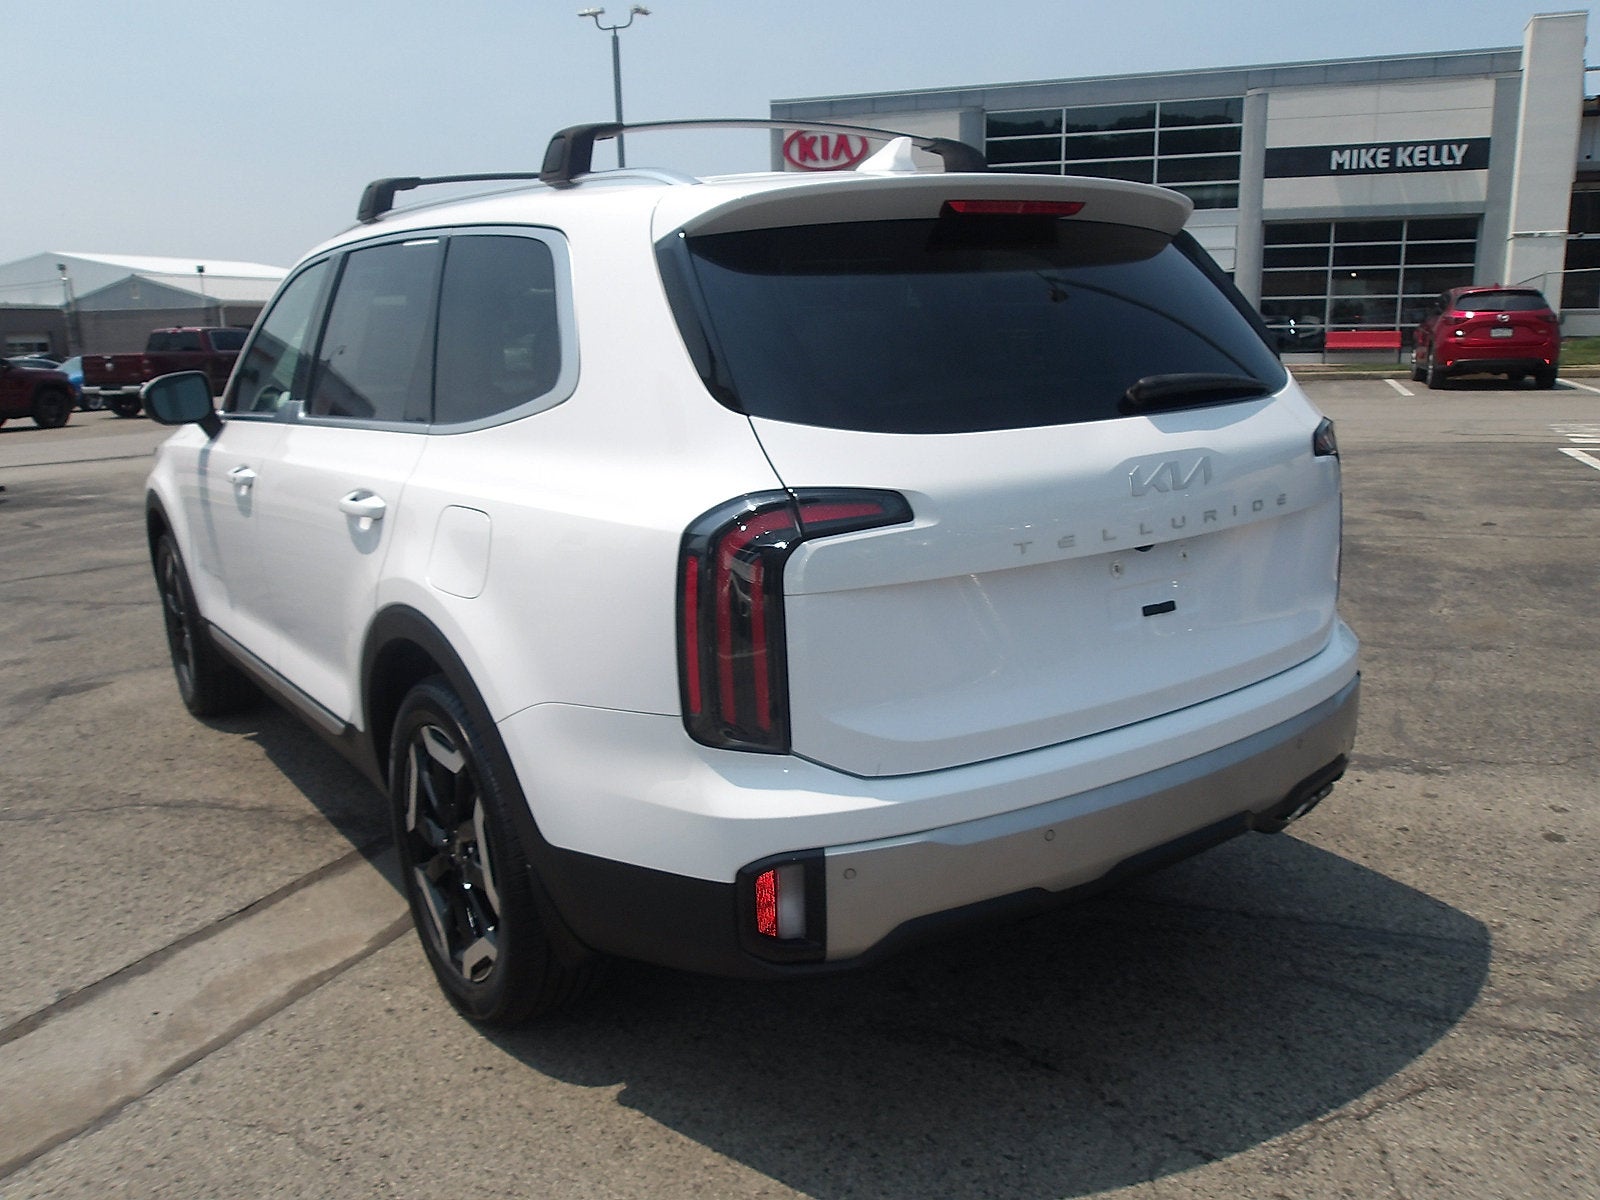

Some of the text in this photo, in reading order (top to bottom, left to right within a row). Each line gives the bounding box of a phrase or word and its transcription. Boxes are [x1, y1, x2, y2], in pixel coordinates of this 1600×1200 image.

[798, 133, 855, 161] KIA
[1330, 143, 1469, 170] MIKE KELLY
[1128, 456, 1213, 497] KIA
[1013, 493, 1287, 555] TELLURIDE
